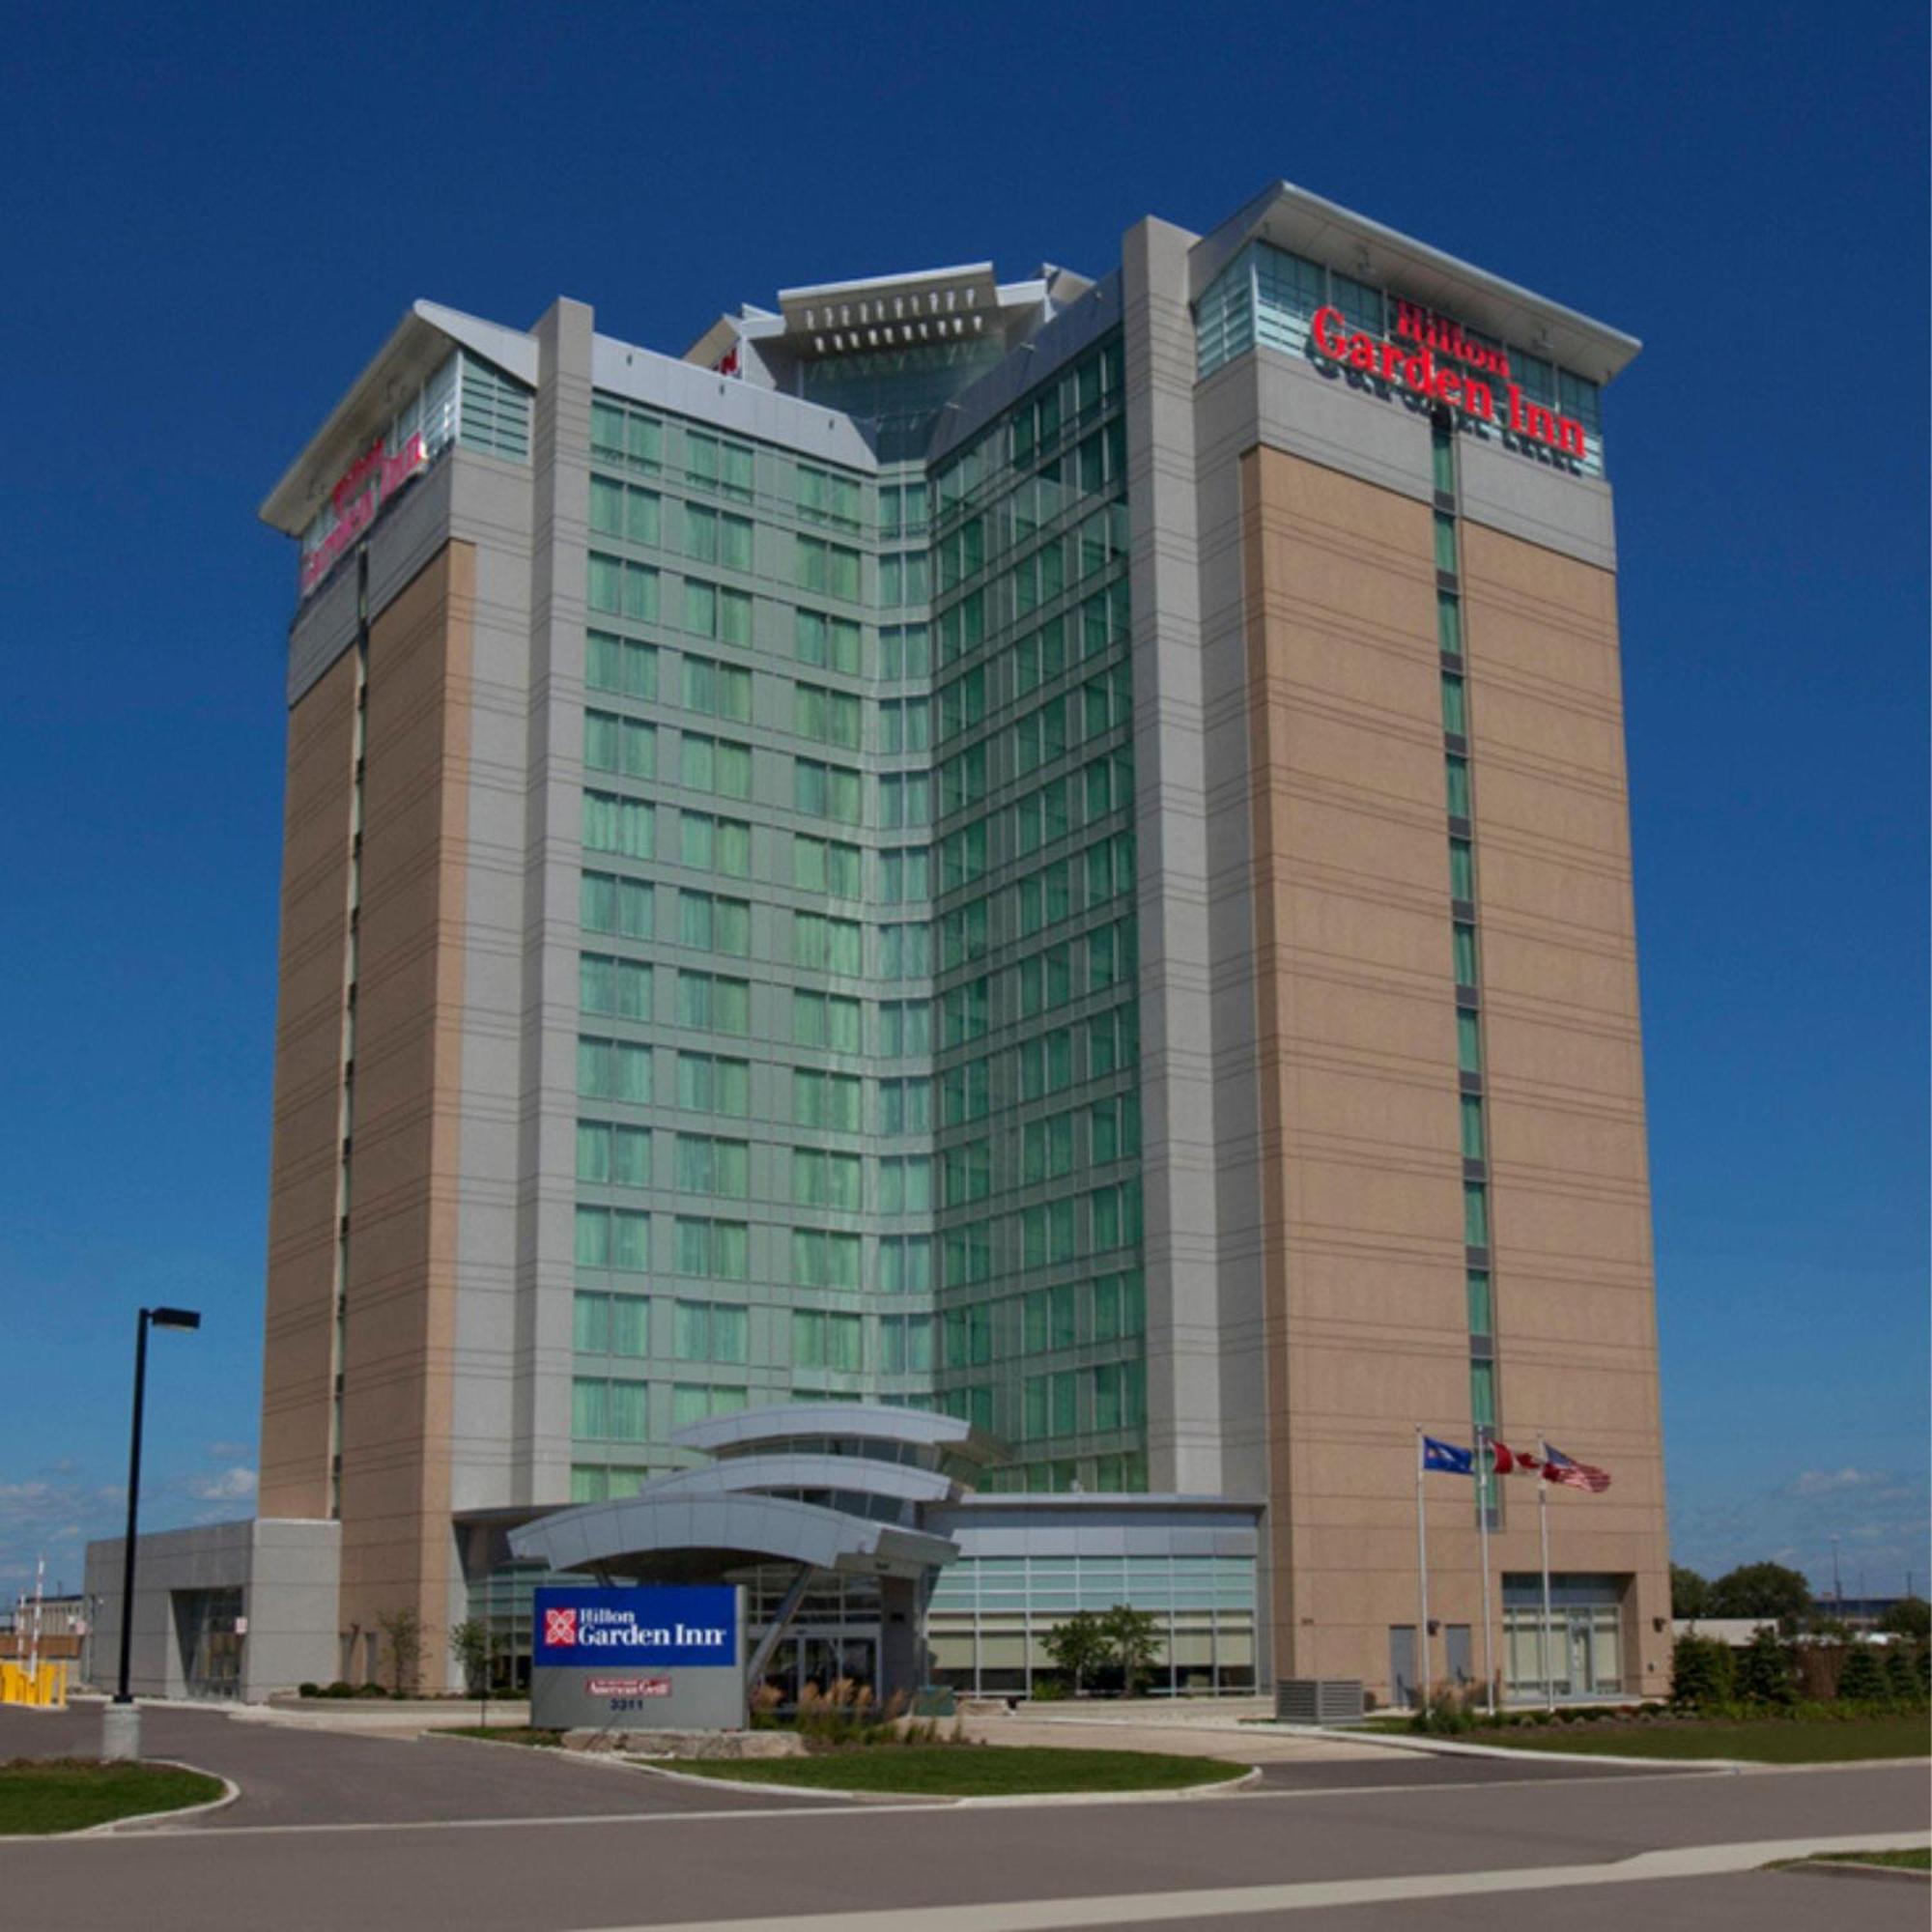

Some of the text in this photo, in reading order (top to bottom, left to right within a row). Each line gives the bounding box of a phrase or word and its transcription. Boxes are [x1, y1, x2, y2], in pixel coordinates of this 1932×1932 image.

[1397, 299, 1510, 378] Hilton
[1312, 305, 1586, 459] Garden Inn
[578, 1623, 724, 1646] Garden Inn
[581, 1607, 635, 1624] Hilton
